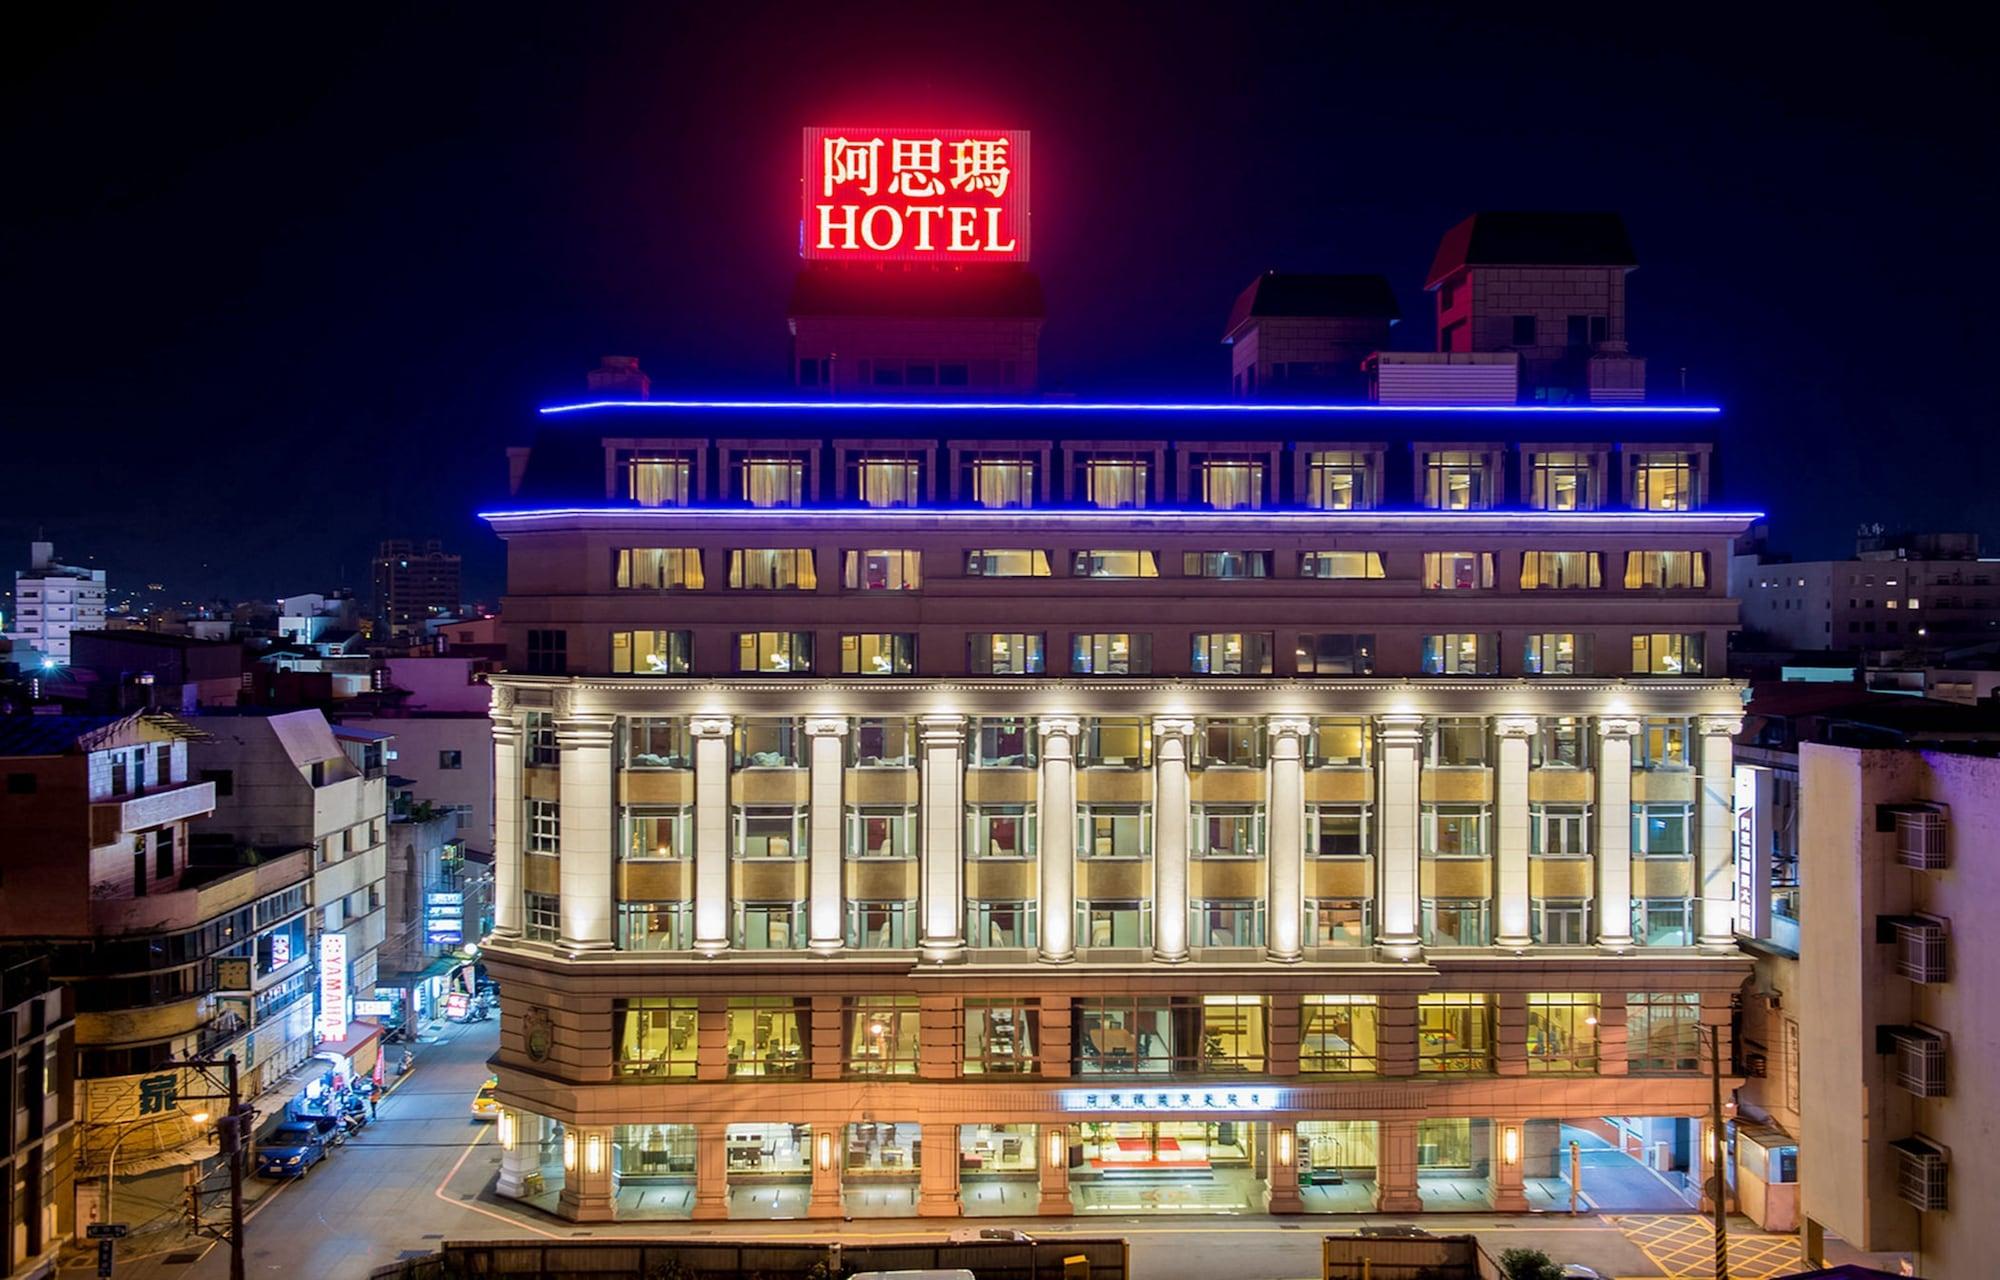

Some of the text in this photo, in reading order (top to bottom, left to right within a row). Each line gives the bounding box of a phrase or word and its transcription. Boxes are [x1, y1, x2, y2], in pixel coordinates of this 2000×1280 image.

[823, 137, 1011, 198] 阿思瑪
[815, 204, 1016, 252] HOTEL
[326, 956, 342, 1028] YAMAHA
